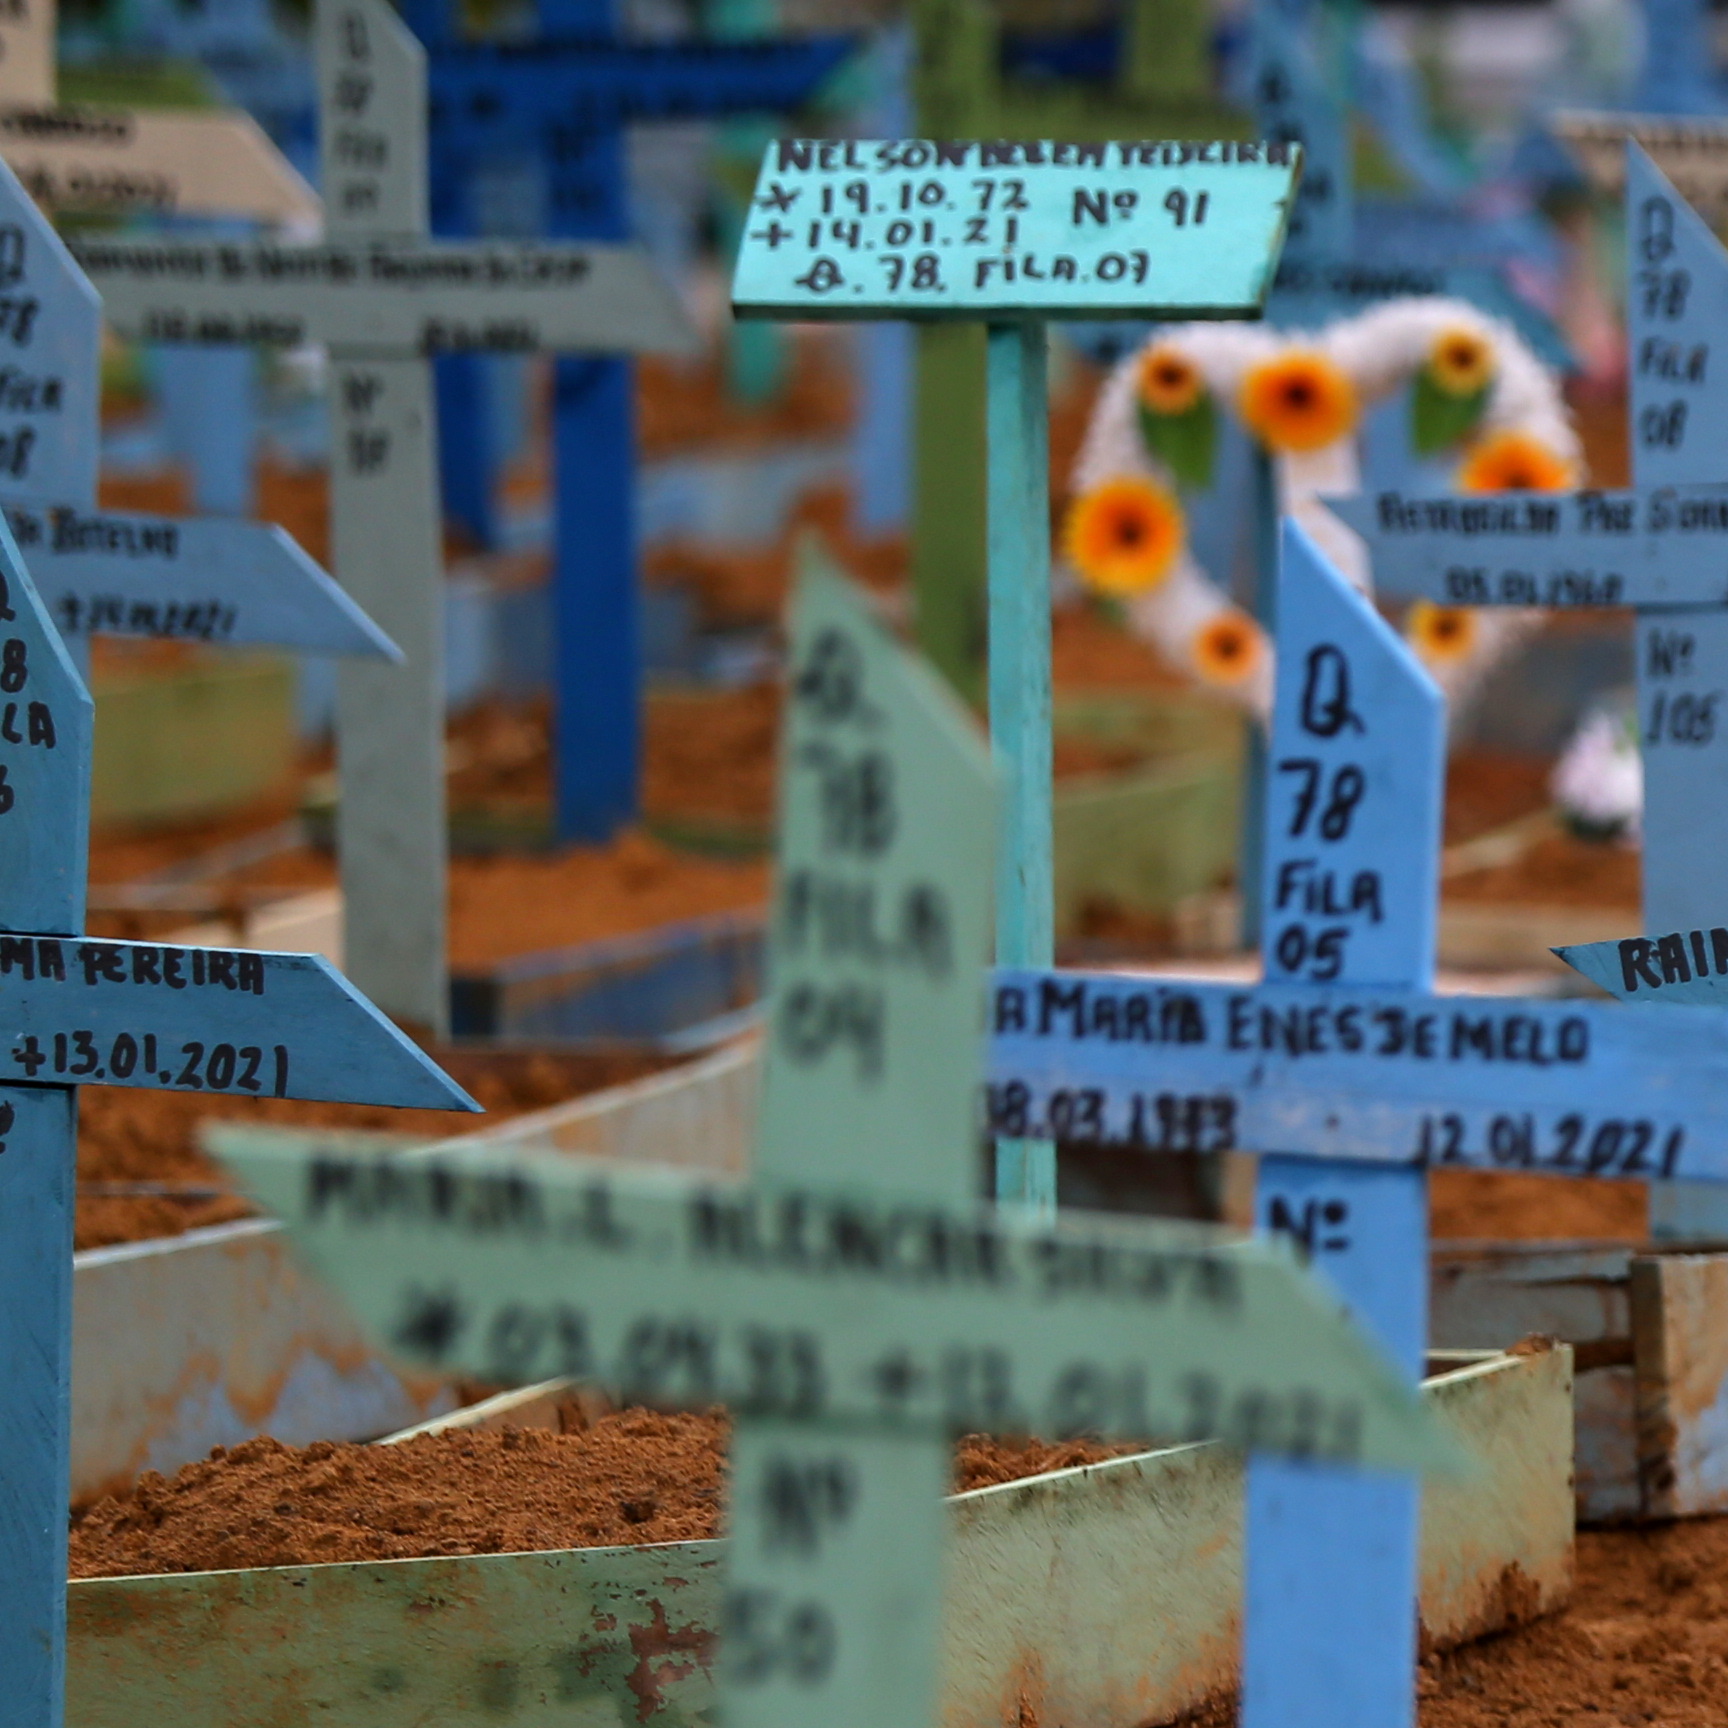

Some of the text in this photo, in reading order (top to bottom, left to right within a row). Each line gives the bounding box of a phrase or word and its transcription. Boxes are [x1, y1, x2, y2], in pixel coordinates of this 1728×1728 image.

[1163, 186, 1210, 228] 91
[1300, 643, 1366, 740] Q
[1277, 758, 1369, 843] 78
[77, 941, 265, 995] PEREIRA
[1274, 928, 1350, 981] 05
